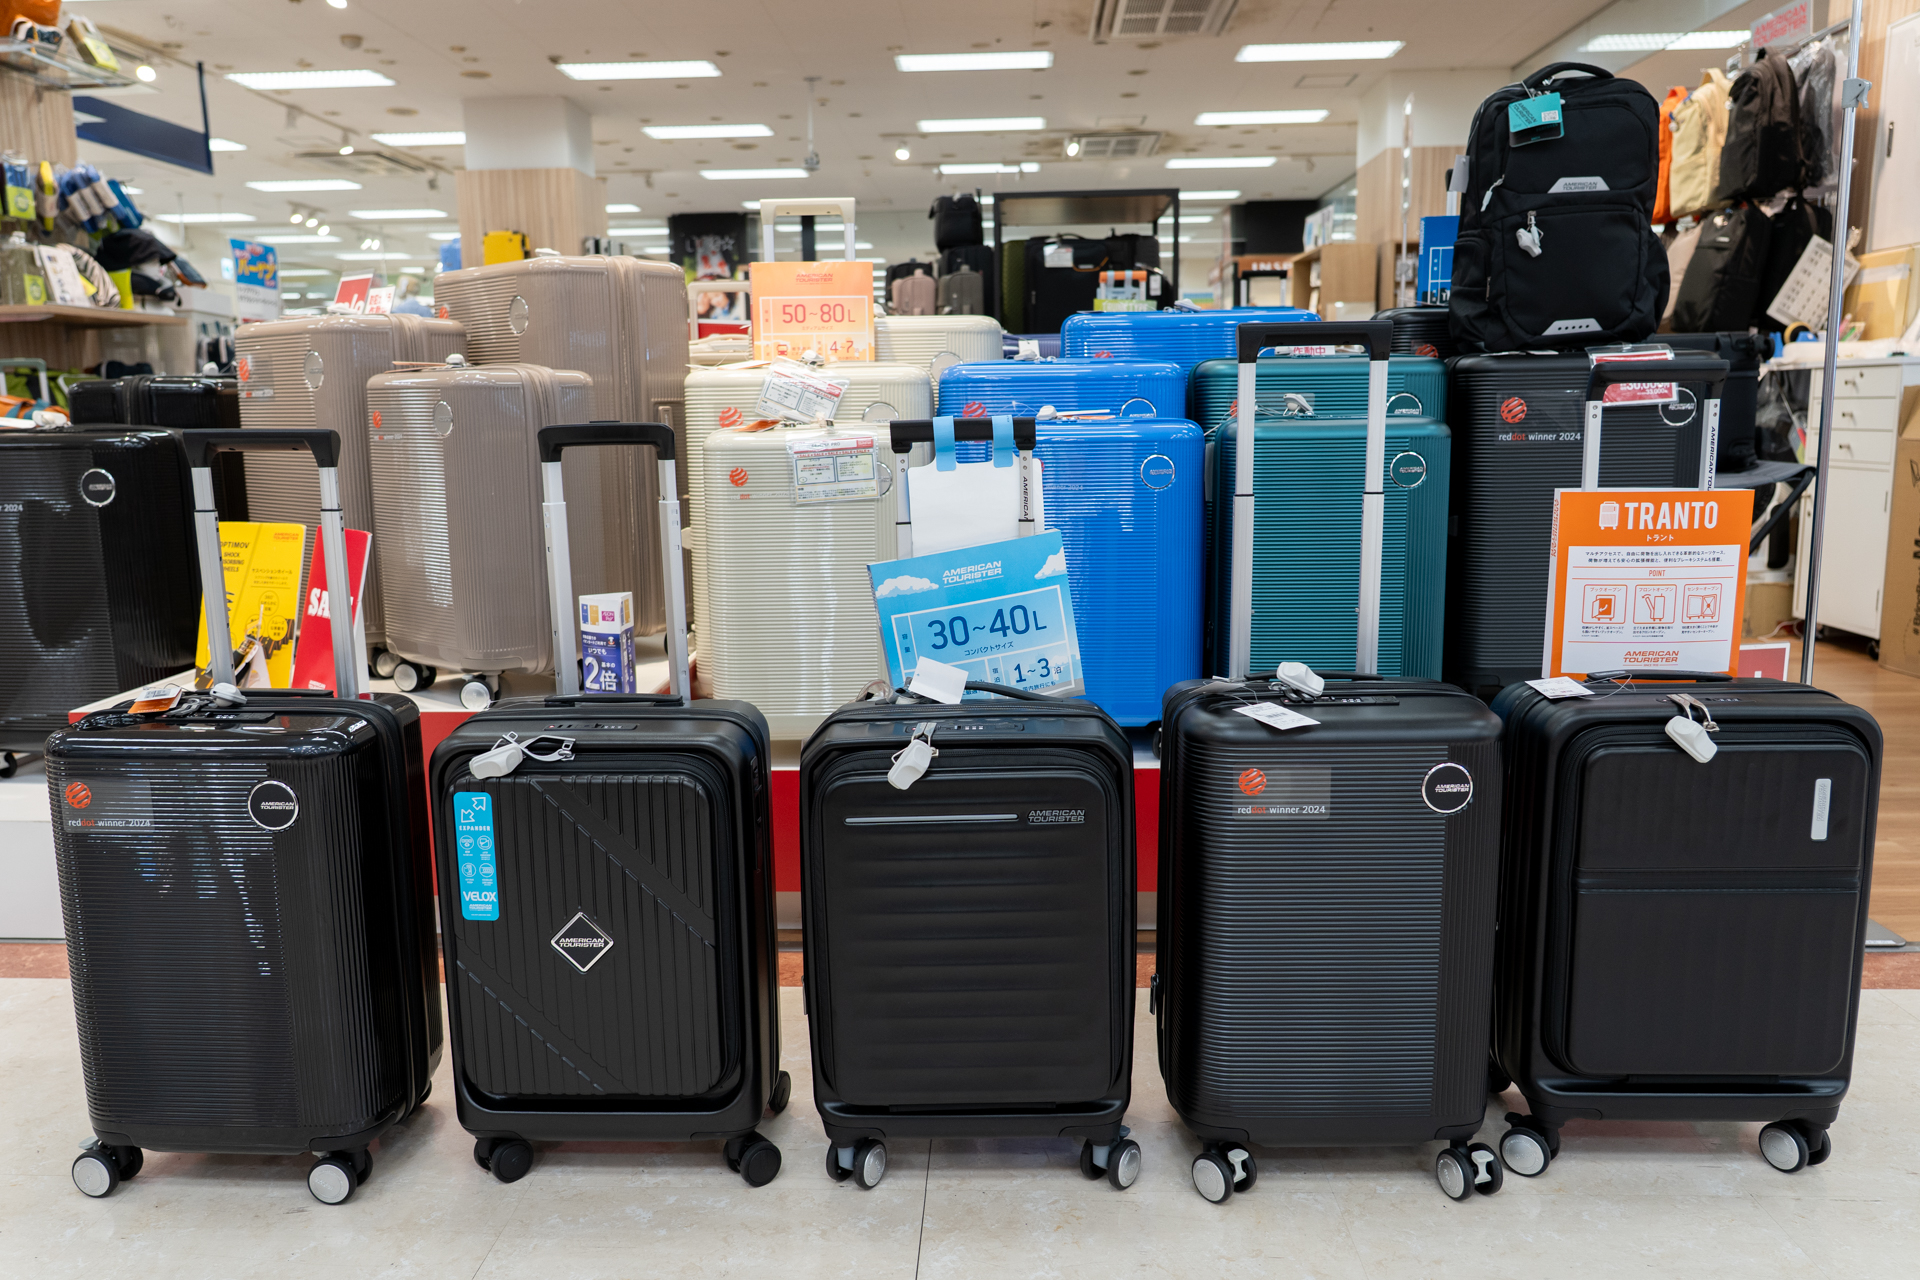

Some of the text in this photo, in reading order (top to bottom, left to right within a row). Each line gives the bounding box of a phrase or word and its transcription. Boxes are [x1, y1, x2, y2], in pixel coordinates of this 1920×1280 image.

[1498, 432, 1581, 441] reddot winner 2024
[1708, 425, 1716, 474] AMERICAN
[4, 504, 24, 512] 2024
[1624, 501, 1719, 530] TRANTO
[1646, 534, 1675, 542] トラント
[942, 560, 1002, 578] AMERICAN
[1648, 569, 1666, 577] POINT
[942, 568, 1002, 585] TOURISTER
[587, 647, 607, 656] いつでも
[964, 641, 1014, 656] コンパクトサイズ
[1028, 809, 1086, 817] AMERICAN
[1237, 805, 1326, 814] reddot winner 2024
[68, 818, 150, 827] reddot winner 2024
[462, 890, 497, 902] VELOX
